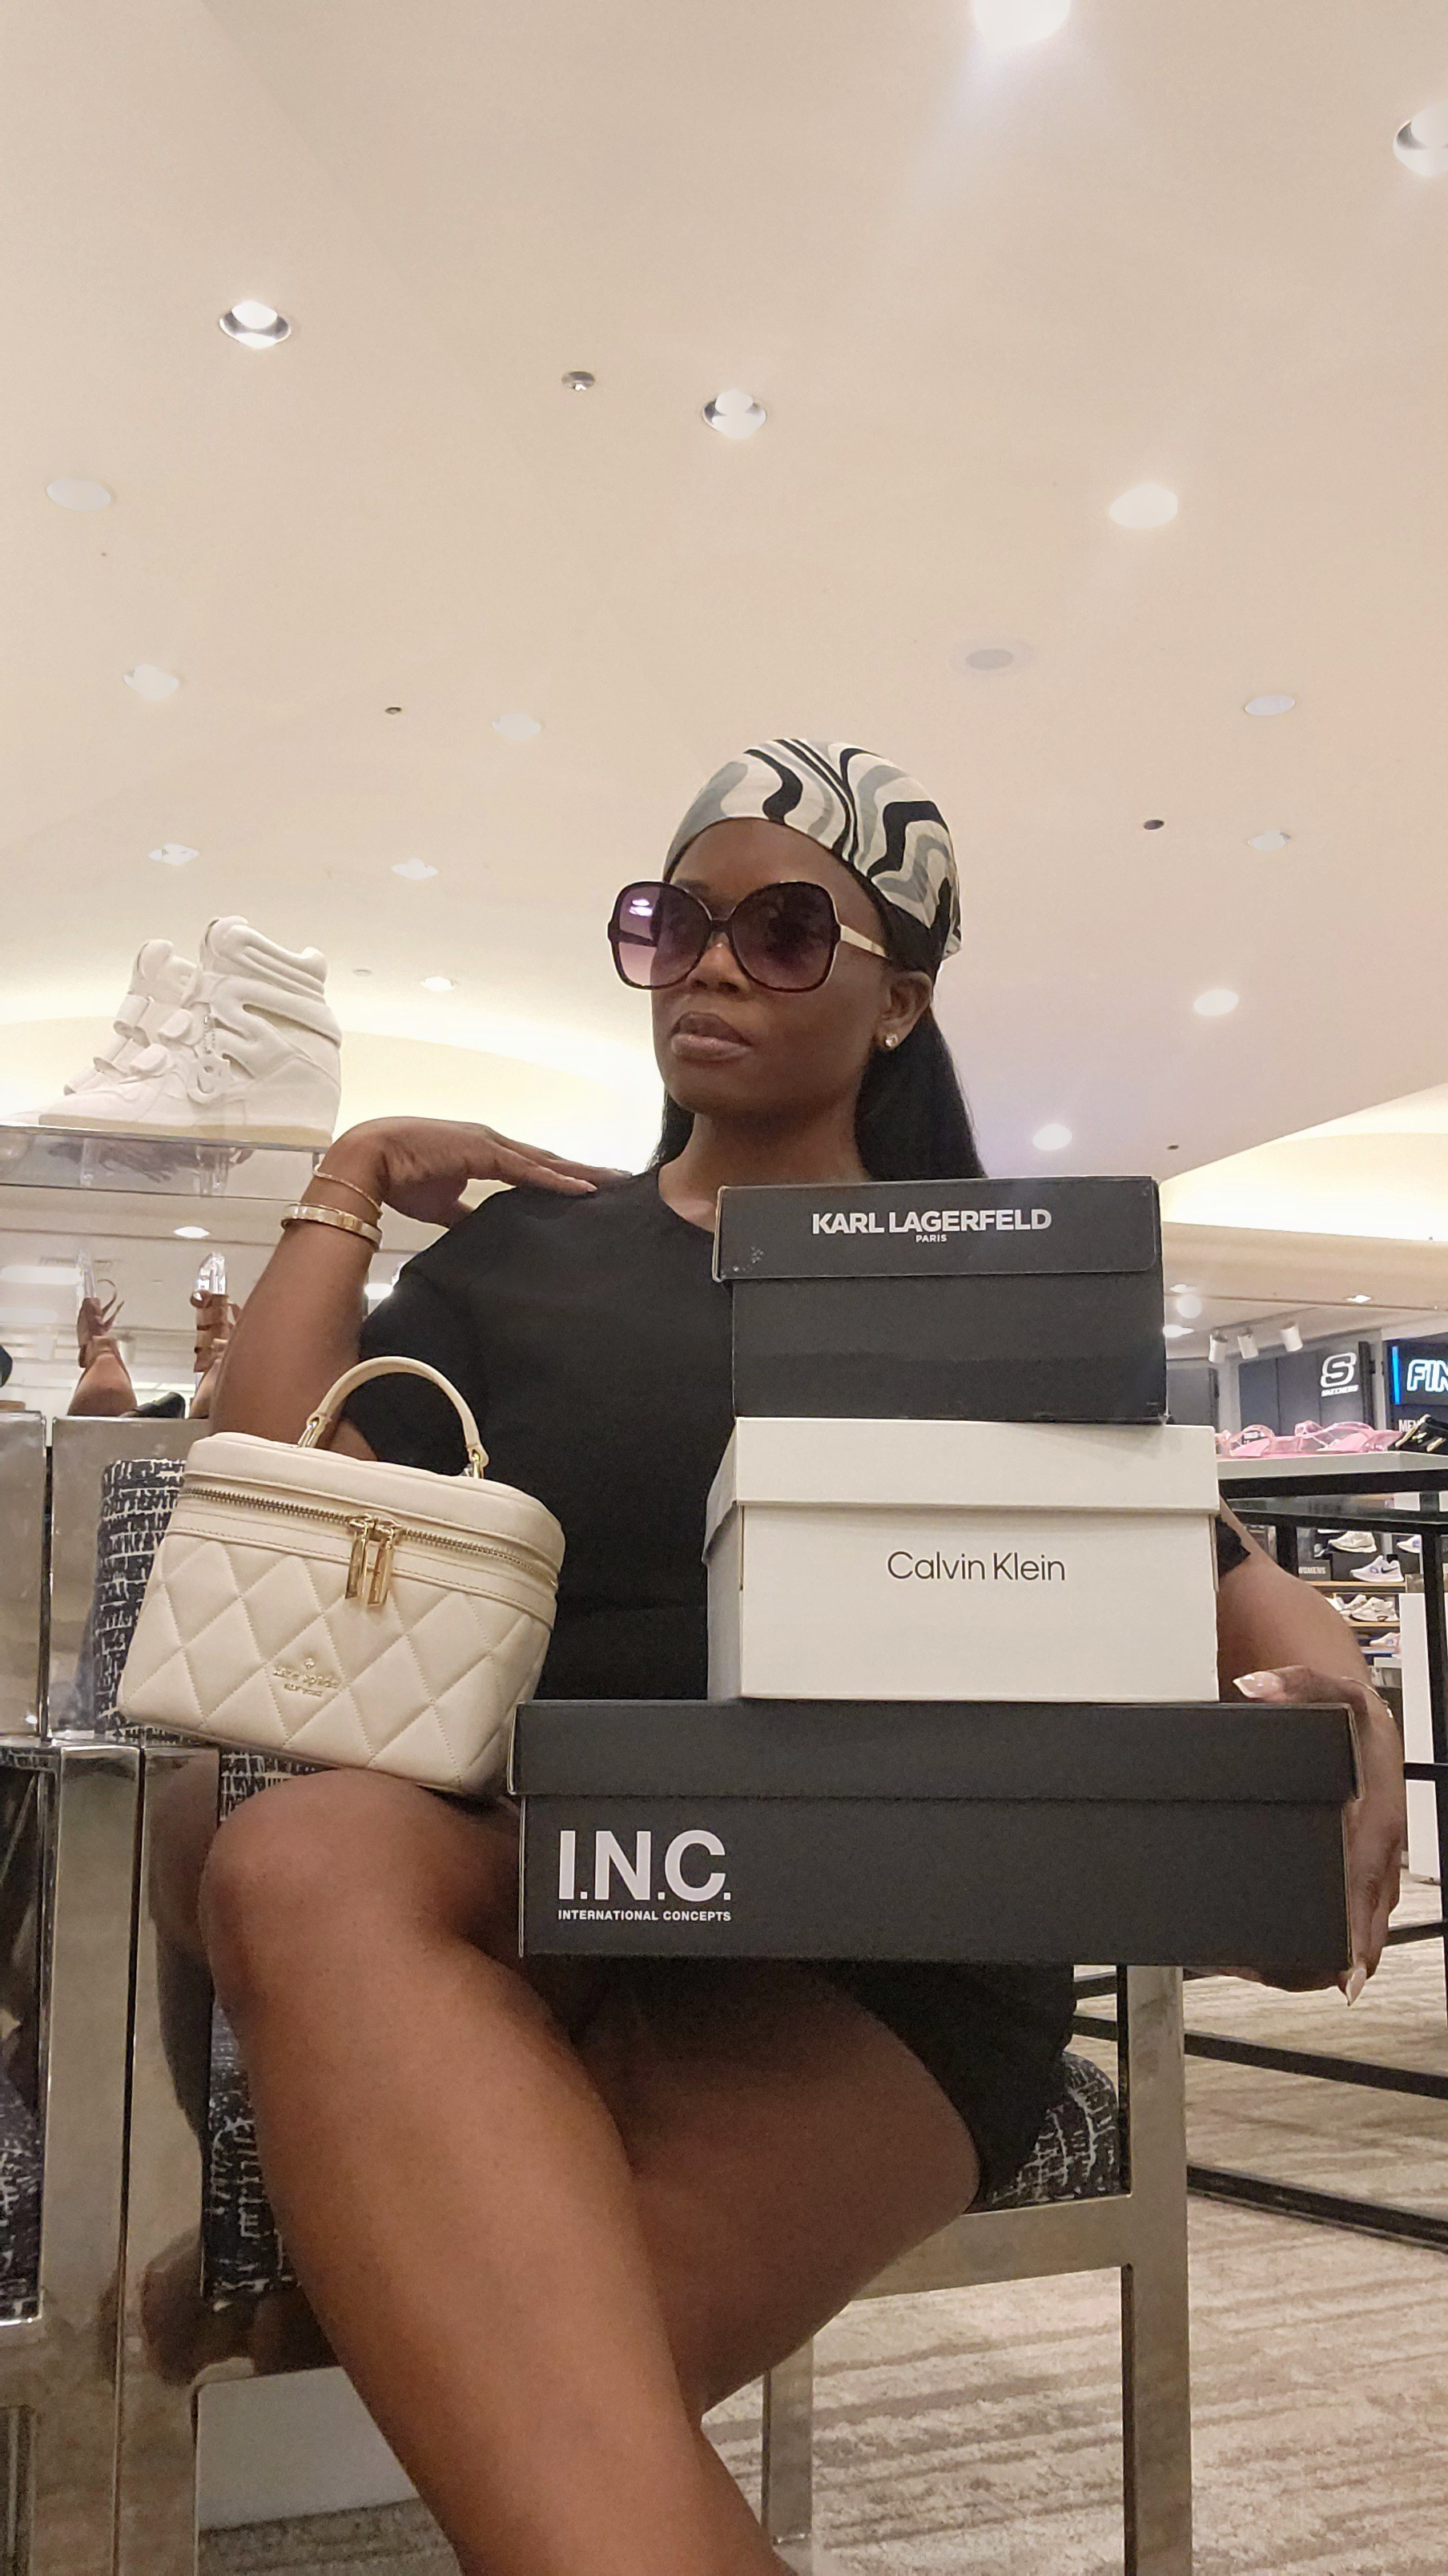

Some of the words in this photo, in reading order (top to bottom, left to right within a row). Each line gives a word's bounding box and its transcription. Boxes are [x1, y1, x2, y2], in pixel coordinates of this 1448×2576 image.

[812, 1212, 885, 1234] KARL
[888, 1209, 1052, 1234] LAGERFELD
[915, 1234, 947, 1242] PARIS
[887, 1551, 985, 1580] Calvin
[993, 1552, 1065, 1581] Klein
[559, 1829, 731, 1902] I.N.C.
[558, 1910, 658, 1920] INTERNATIONAL
[662, 1910, 731, 1922] CONCEPTS
